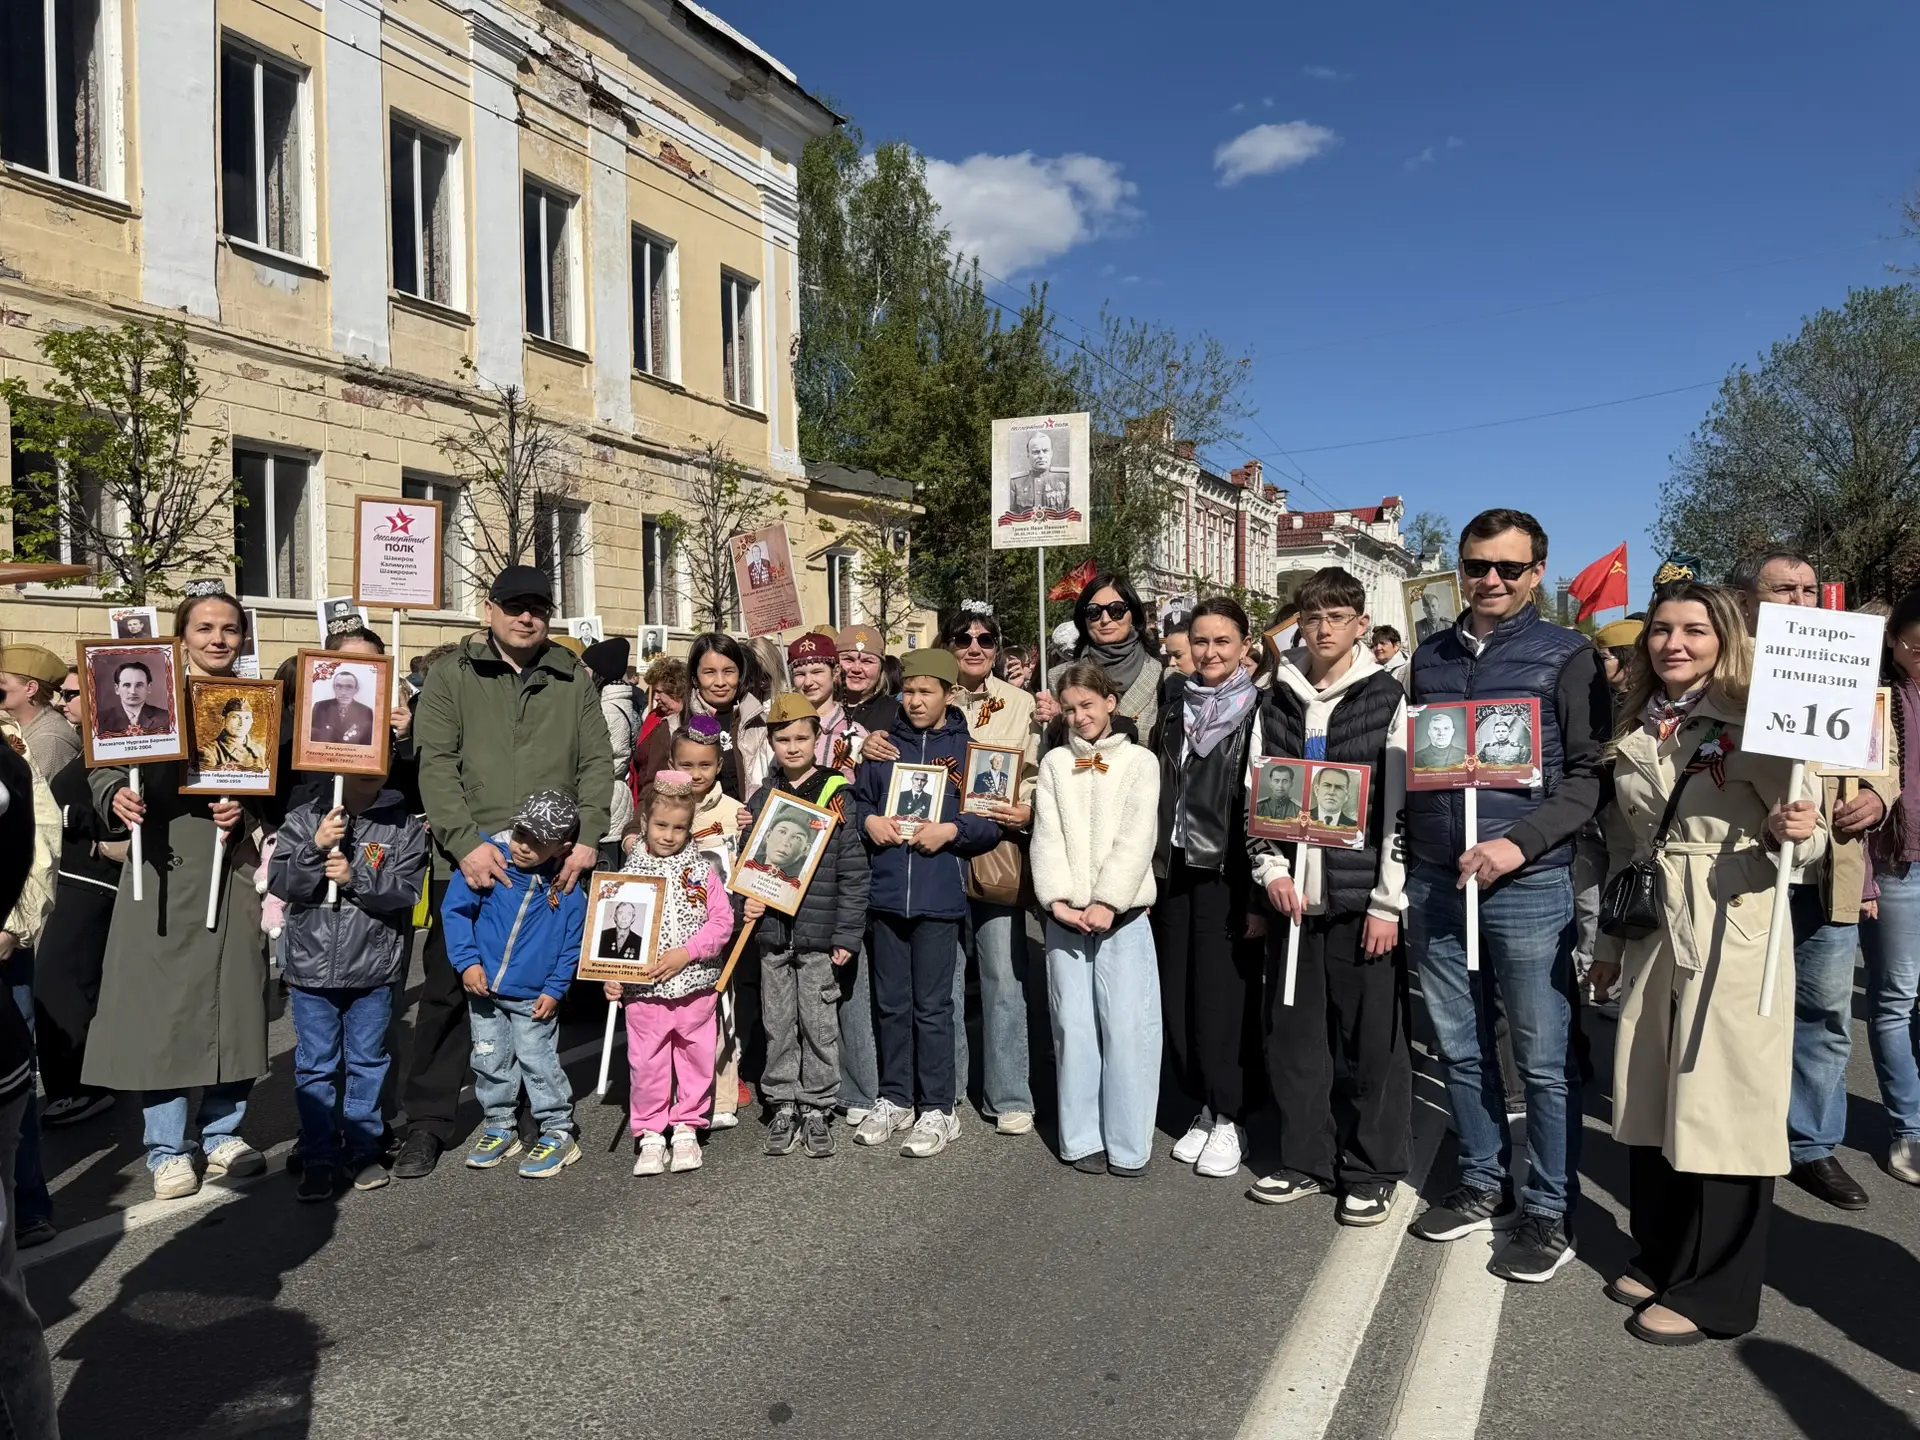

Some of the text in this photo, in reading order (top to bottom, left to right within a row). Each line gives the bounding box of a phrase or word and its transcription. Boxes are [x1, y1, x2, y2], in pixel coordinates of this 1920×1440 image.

[384, 543, 415, 553] ПОЛК
[1785, 620, 1856, 642] Татаро-
[1765, 644, 1870, 667] английская
[1772, 668, 1858, 689] гимназия
